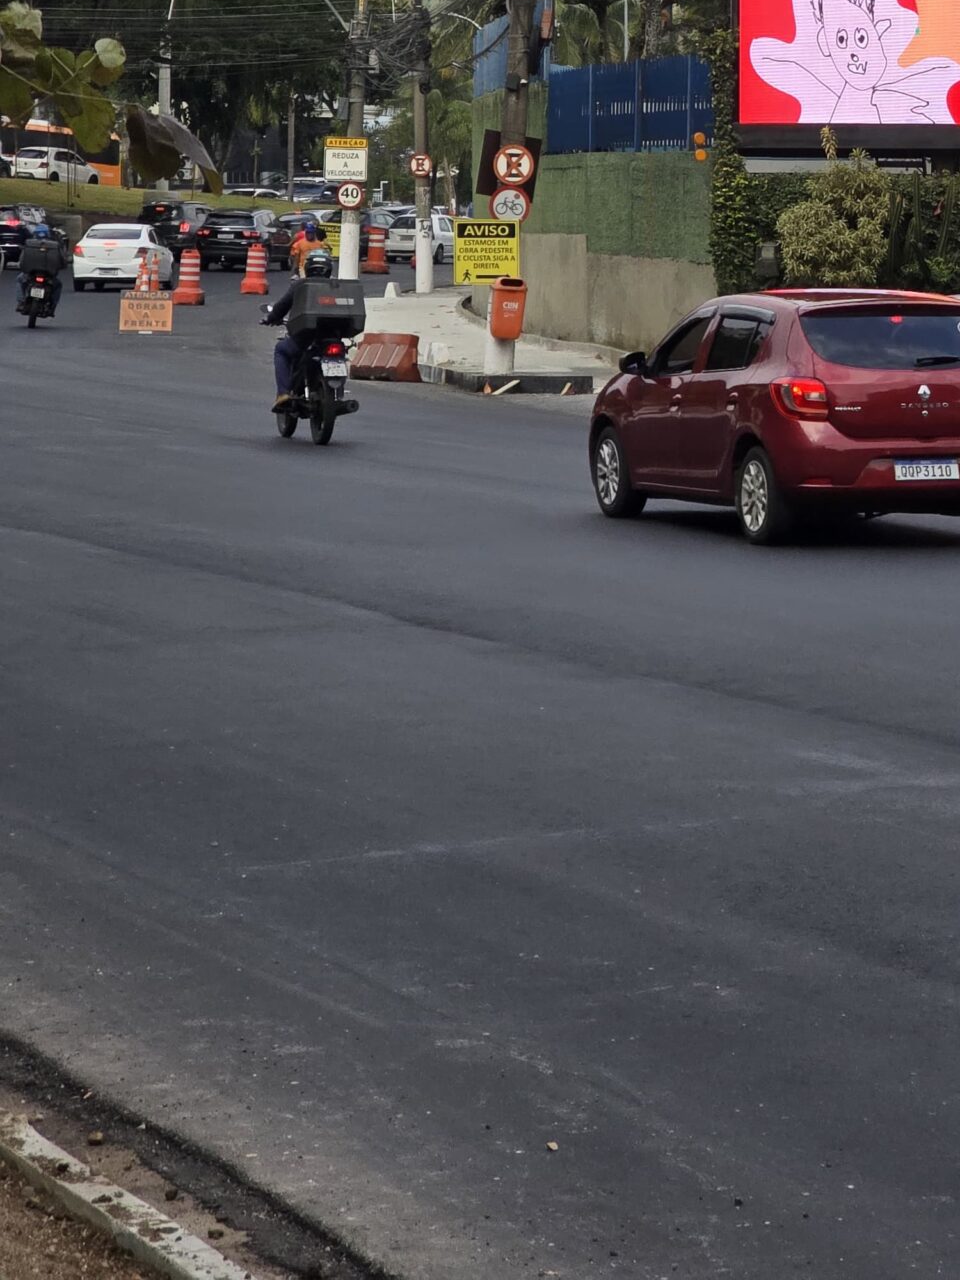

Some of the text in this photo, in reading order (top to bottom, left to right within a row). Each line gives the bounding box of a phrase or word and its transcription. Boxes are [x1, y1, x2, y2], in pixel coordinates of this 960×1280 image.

[332, 152, 359, 160] REDUZA
[340, 187, 359, 199] 40
[463, 225, 509, 236] AVISO
